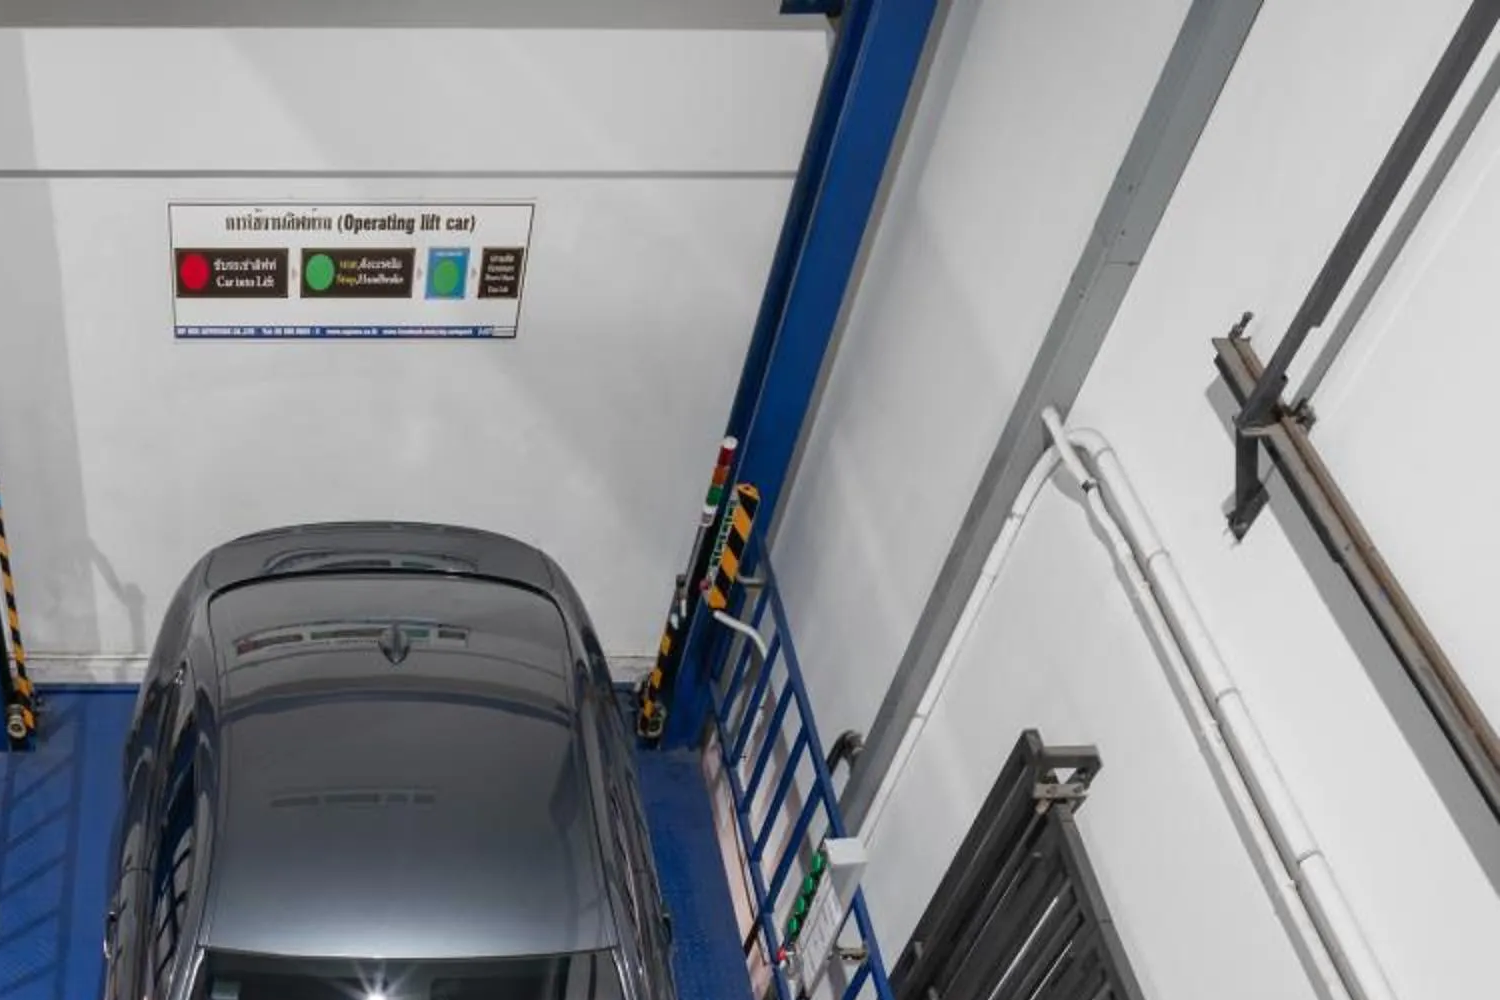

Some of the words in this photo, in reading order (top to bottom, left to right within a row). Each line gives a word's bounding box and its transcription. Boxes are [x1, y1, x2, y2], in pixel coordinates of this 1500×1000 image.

[337, 213, 415, 234] (Operating
[420, 213, 440, 231] lift
[446, 214, 476, 232] car)
[215, 275, 234, 288] Car
[256, 275, 275, 288] Lift
